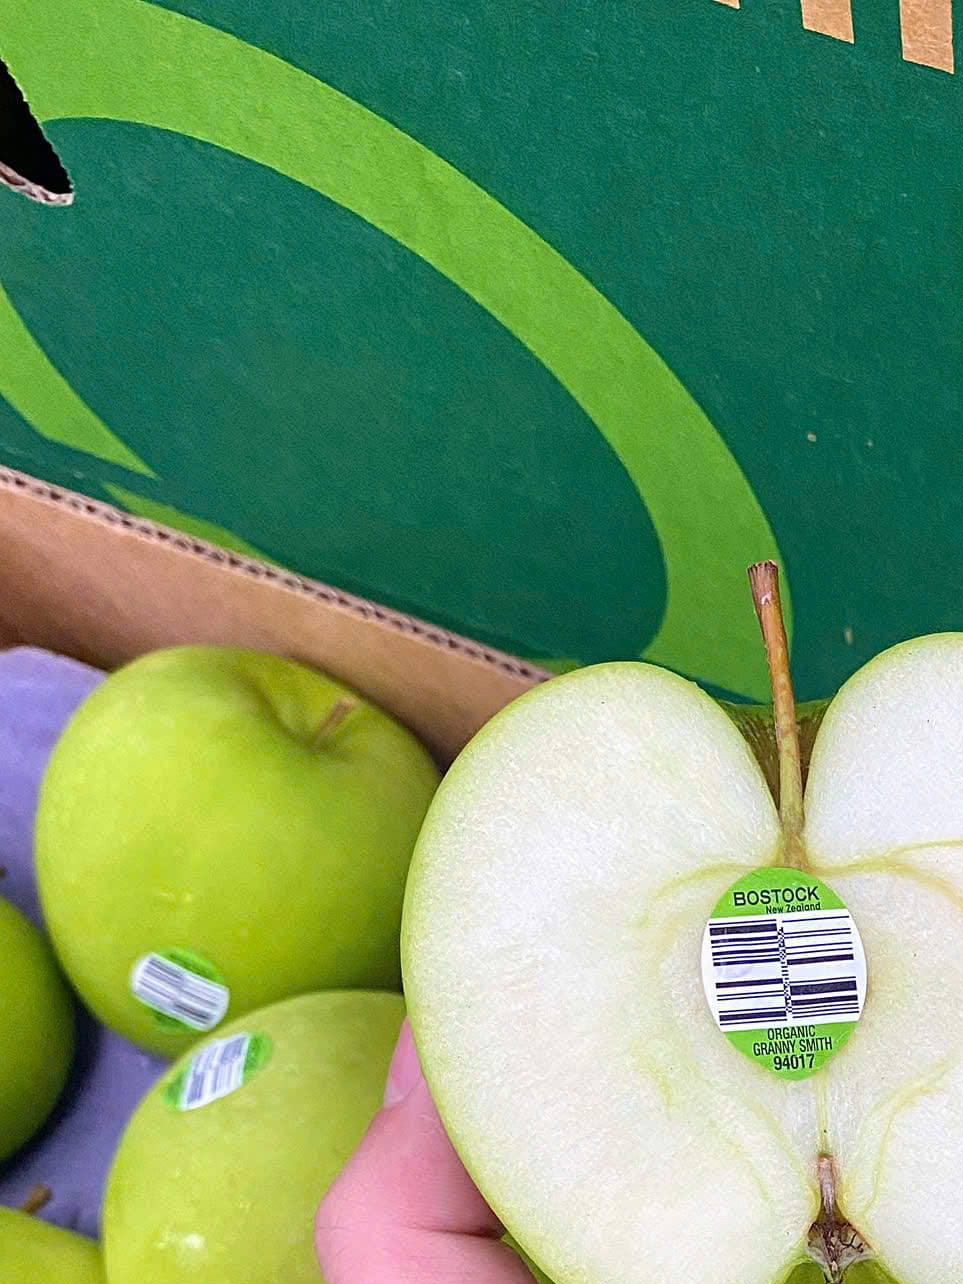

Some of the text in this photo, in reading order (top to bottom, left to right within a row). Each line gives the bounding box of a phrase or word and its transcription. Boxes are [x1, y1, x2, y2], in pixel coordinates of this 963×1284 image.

[733, 886, 820, 907] BOSTOCK
[765, 902, 821, 915] New Zealand
[767, 1025, 816, 1041] ORGANIC
[753, 1037, 833, 1056] GRANNY SMITH
[773, 1054, 815, 1070] 94017
